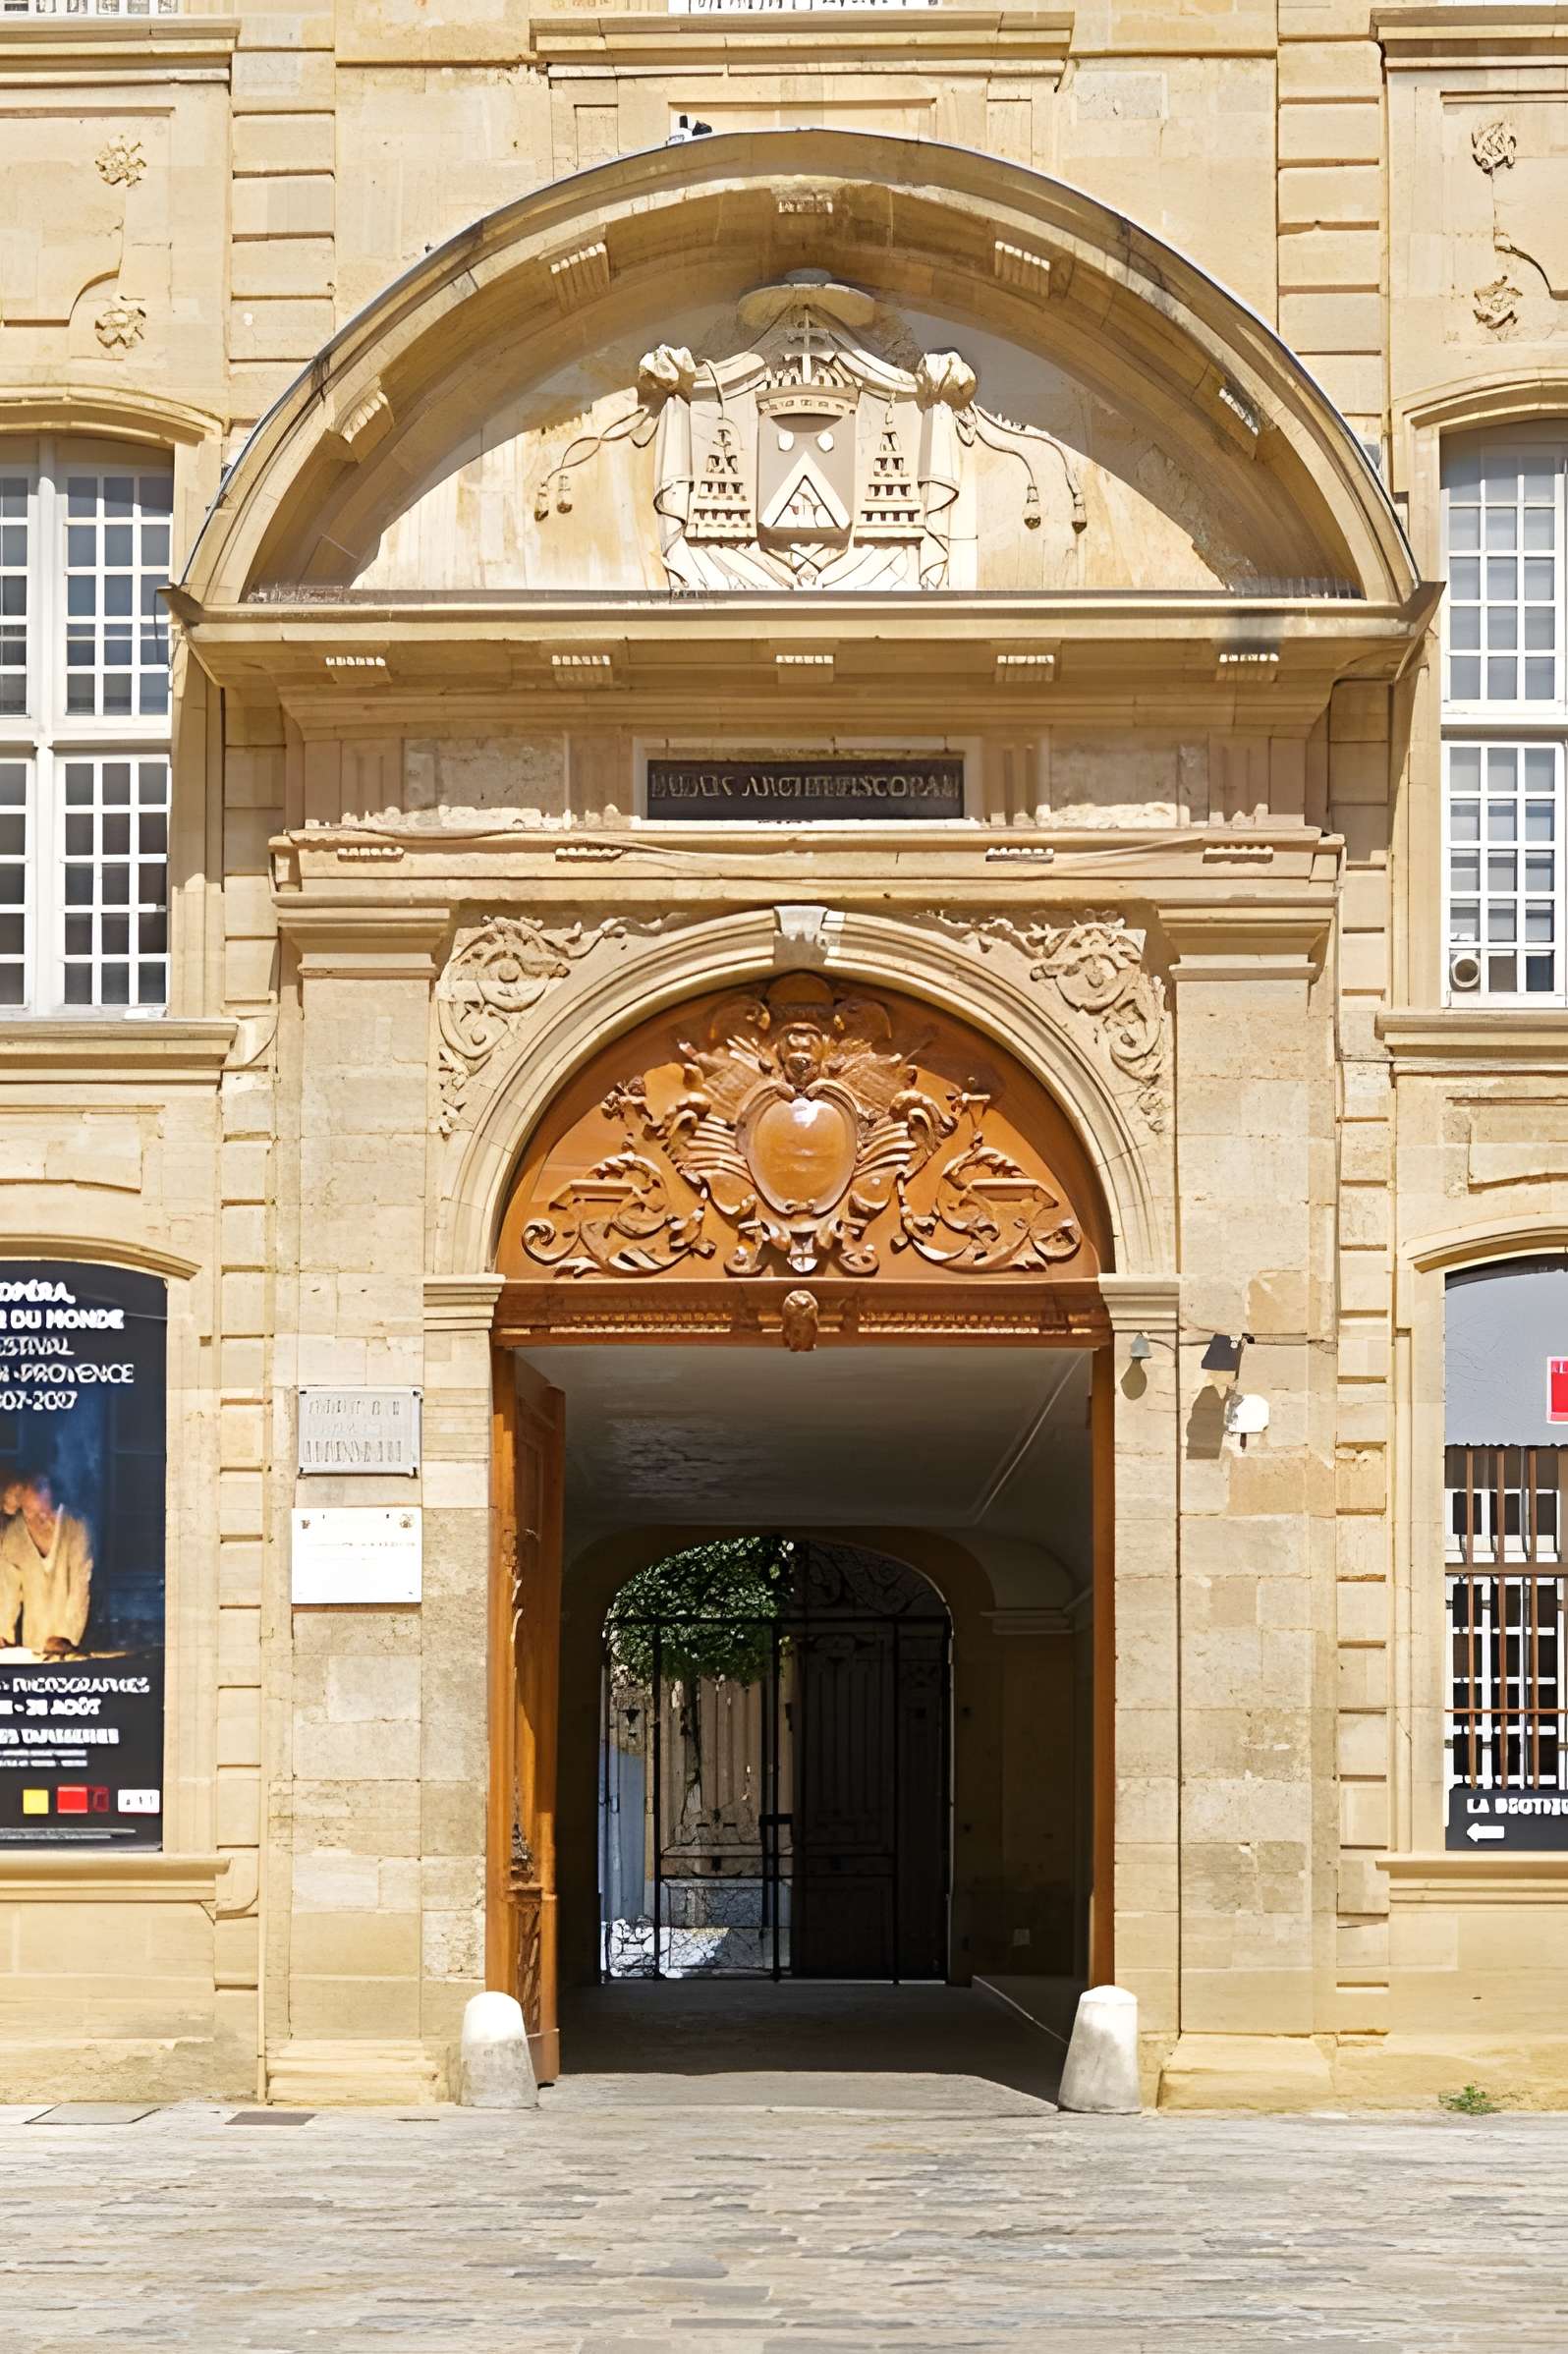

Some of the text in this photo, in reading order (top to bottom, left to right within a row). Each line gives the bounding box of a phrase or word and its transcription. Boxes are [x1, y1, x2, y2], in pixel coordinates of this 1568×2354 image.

[11, 1309, 42, 1329] DU
[46, 1309, 125, 1329] MONDE
[1466, 1799, 1490, 1814] LA
